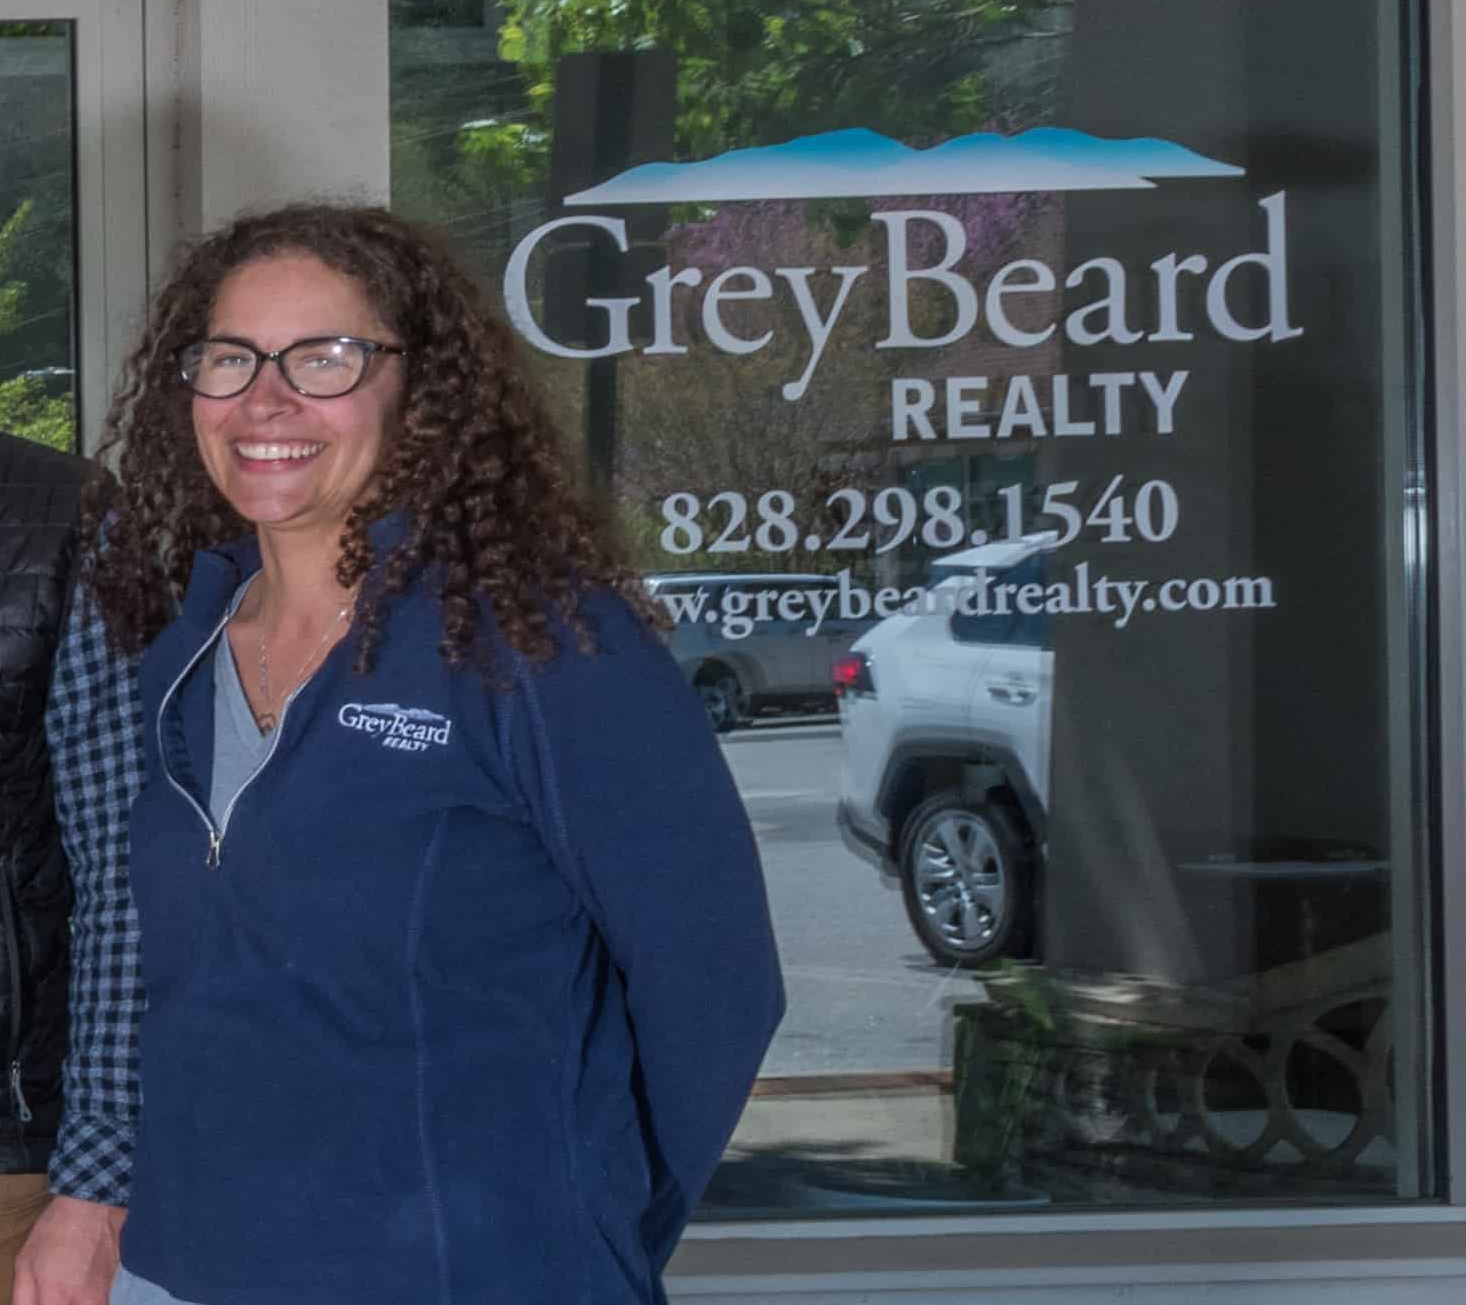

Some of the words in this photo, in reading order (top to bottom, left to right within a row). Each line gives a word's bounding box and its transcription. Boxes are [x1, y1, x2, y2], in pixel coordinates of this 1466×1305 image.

[503, 190, 1304, 401] GreyBeard
[891, 370, 1190, 442] REALTY
[659, 475, 1180, 556] 828.298.1540
[655, 561, 1277, 640] w.greybeardrealty.com
[338, 702, 452, 746] GreyBeard
